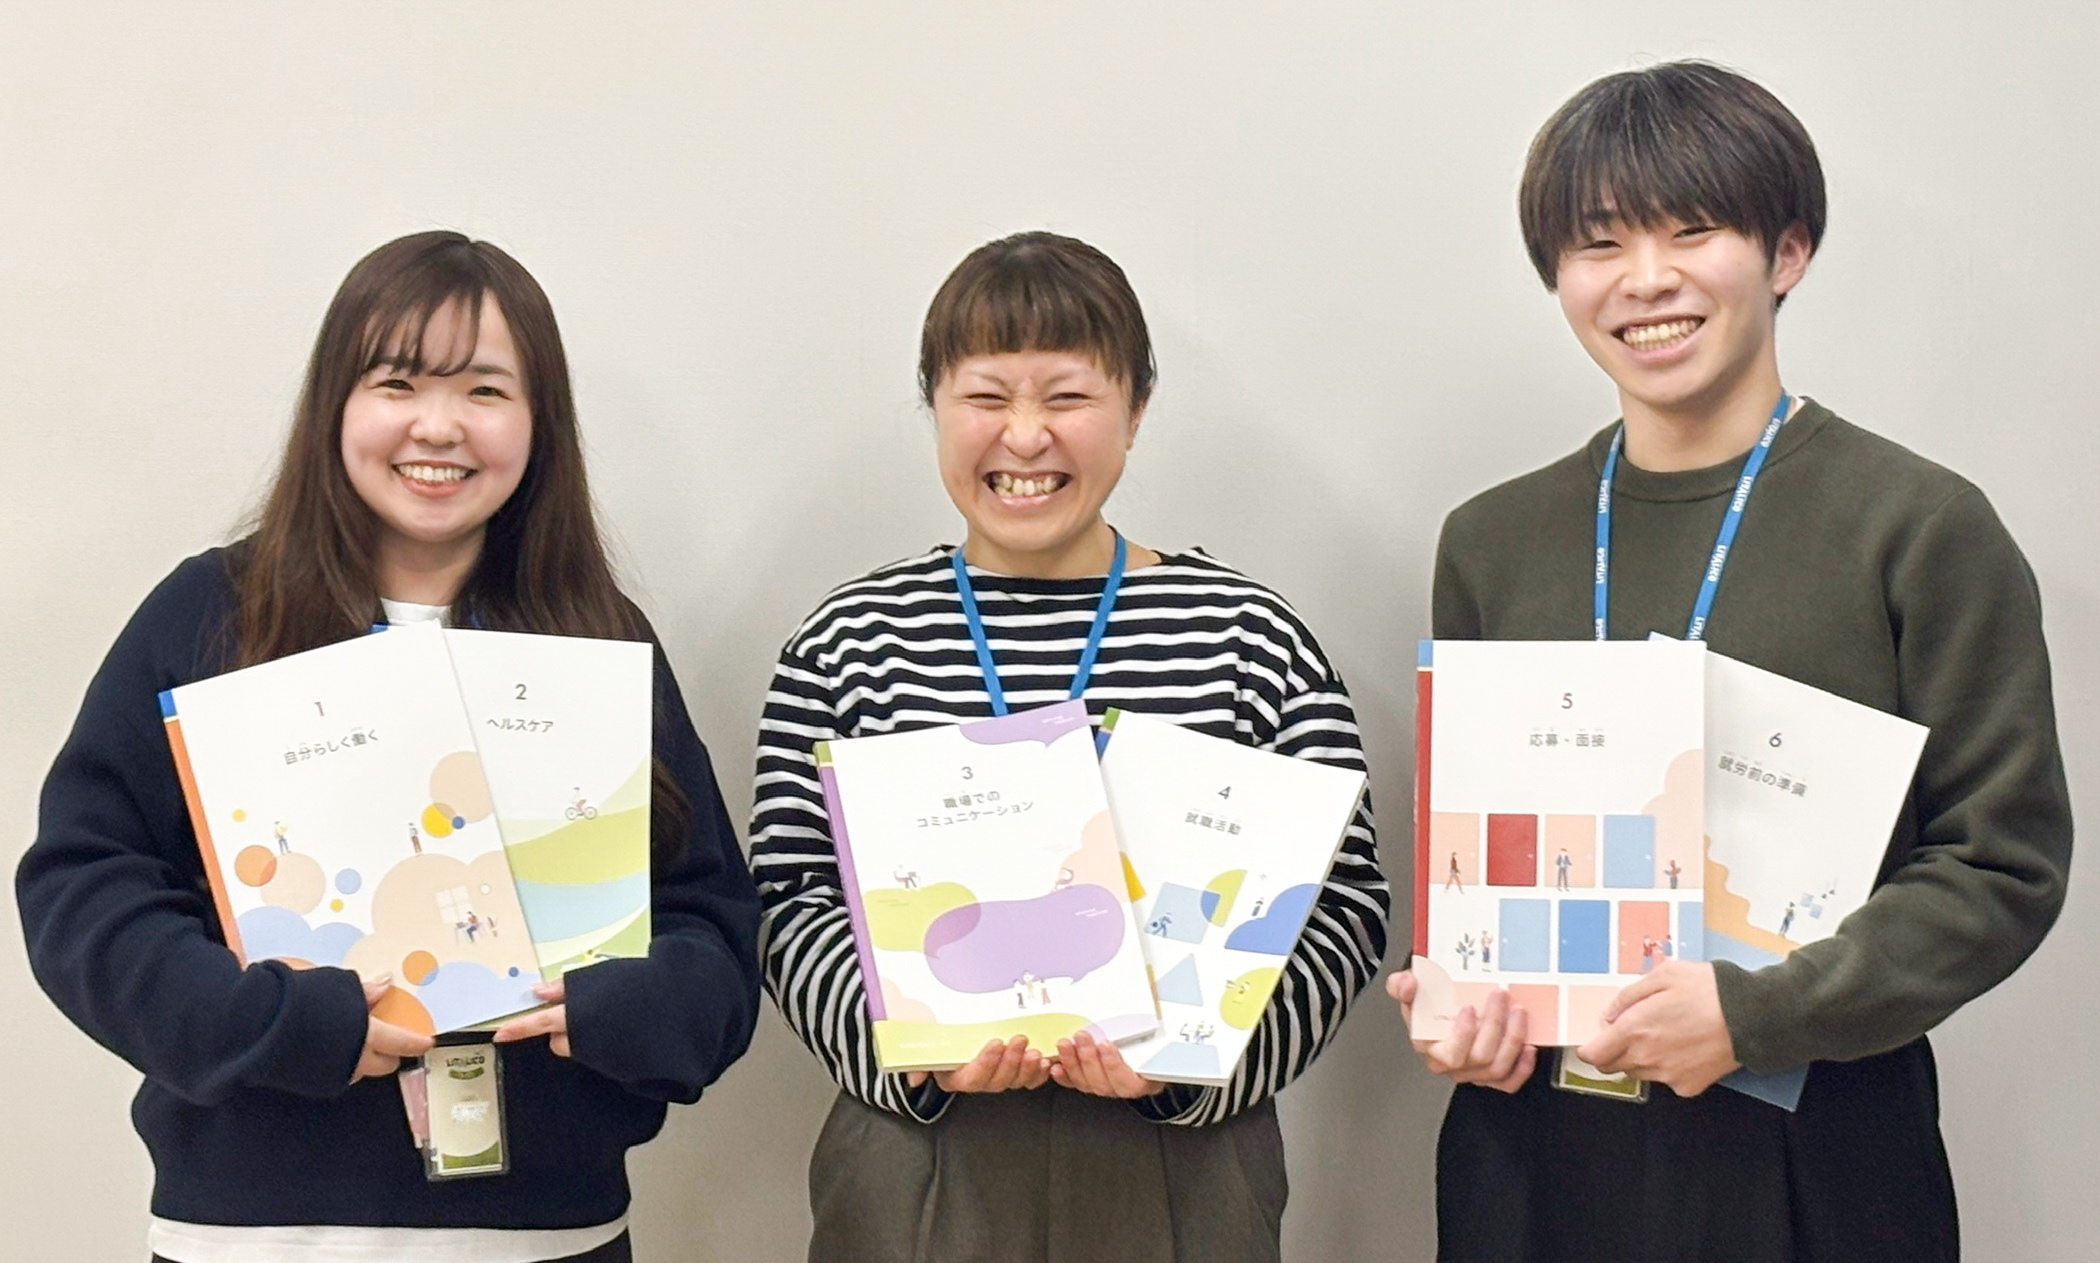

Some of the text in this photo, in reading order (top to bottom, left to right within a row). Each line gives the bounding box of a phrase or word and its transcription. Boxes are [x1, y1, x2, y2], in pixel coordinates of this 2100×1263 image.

[515, 683, 527, 700] 2
[1561, 692, 1573, 709] 5
[314, 701, 325, 717] 1
[486, 718, 554, 733] ヘルスケア
[284, 729, 378, 765] 自分らしく働く
[1768, 732, 1783, 748] 6
[961, 766, 974, 780] 3
[1217, 785, 1231, 800] 4
[917, 801, 1034, 828] コミュニケーション
